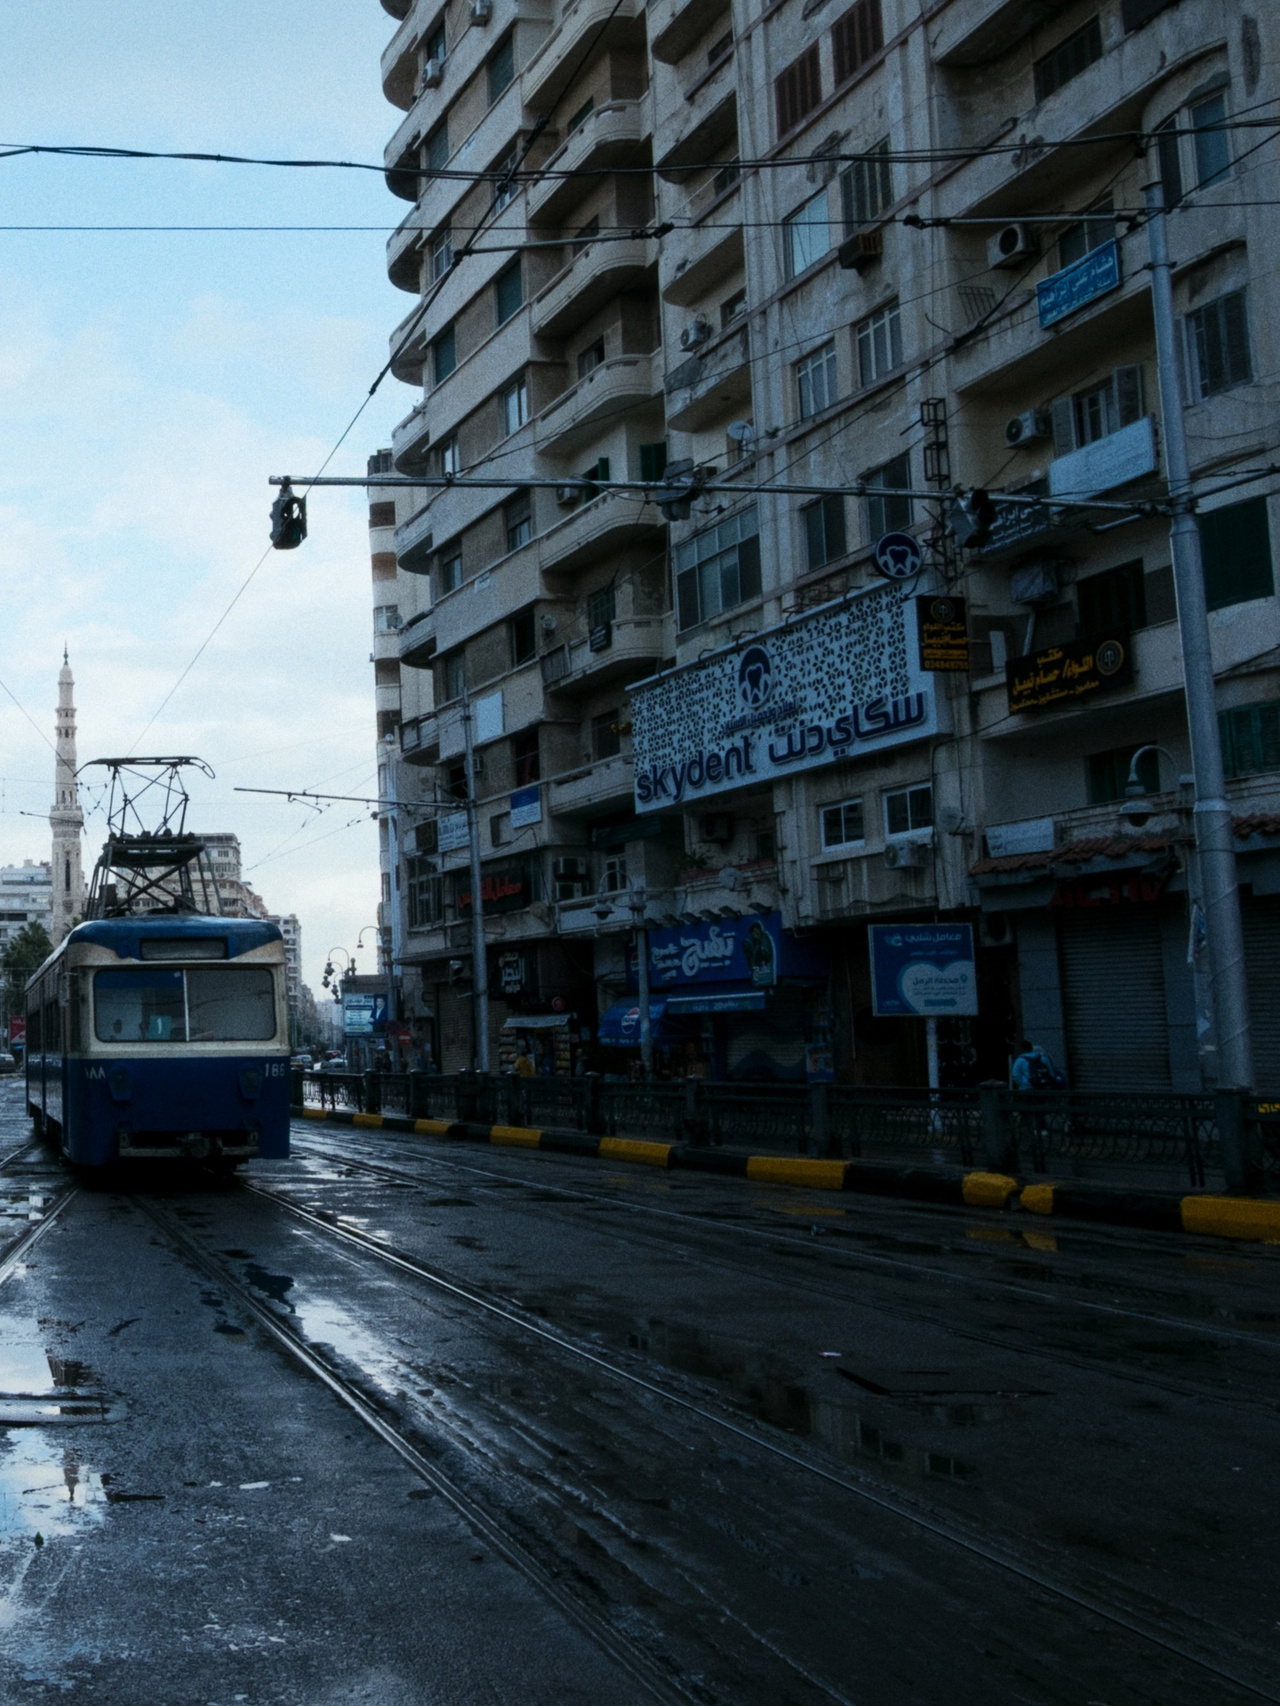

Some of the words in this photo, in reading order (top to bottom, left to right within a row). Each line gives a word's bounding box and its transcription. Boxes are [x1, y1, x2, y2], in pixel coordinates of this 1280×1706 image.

[826, 693, 925, 757] سكاي
[769, 719, 822, 764] دنت
[636, 735, 754, 801] skydent
[905, 931, 933, 944] شلبي
[933, 931, 962, 943] معامل
[912, 976, 934, 986] الرمل
[934, 976, 959, 985] محطة
